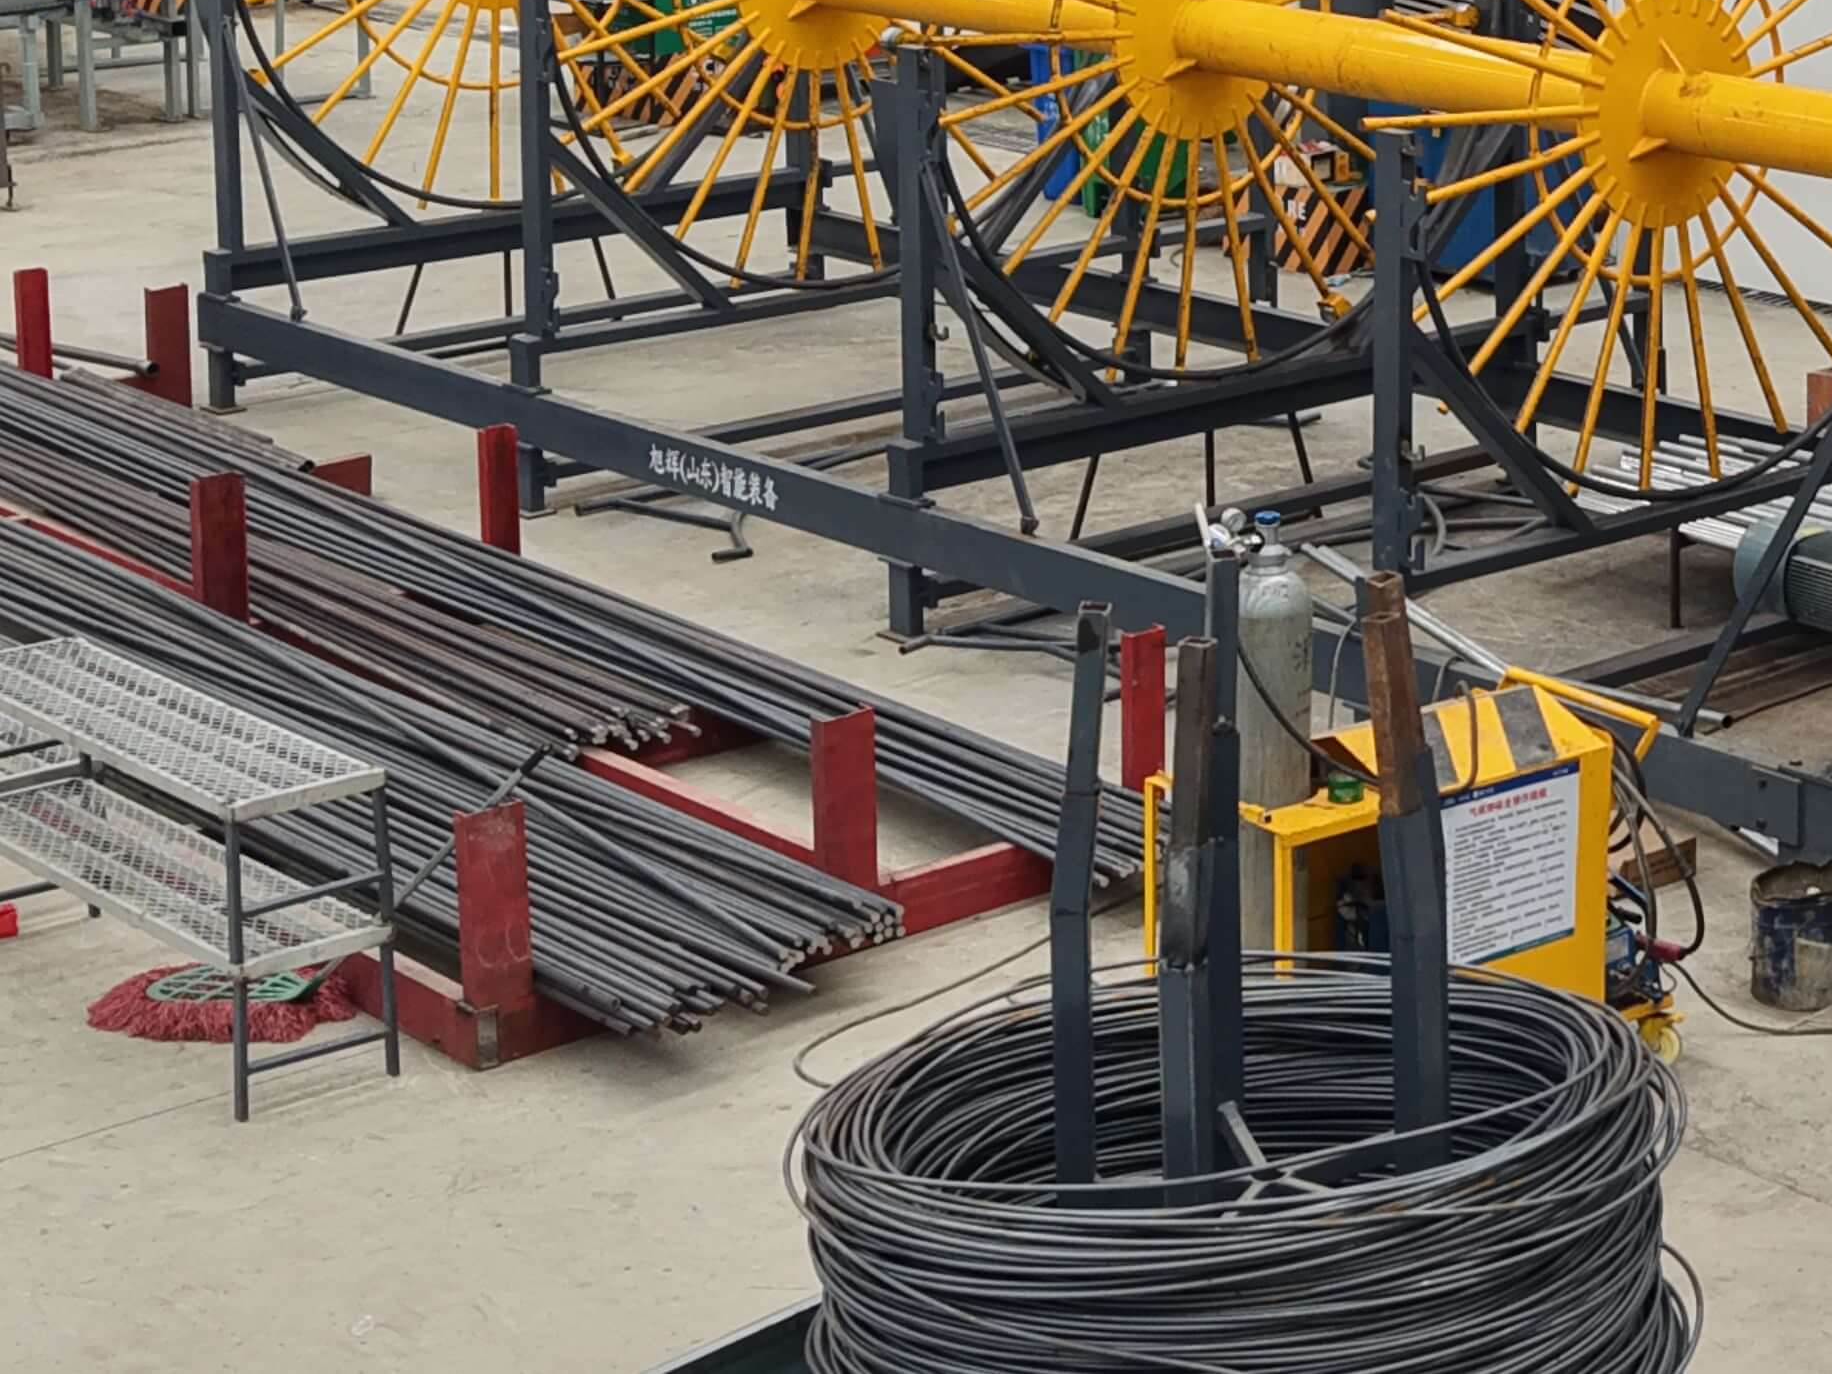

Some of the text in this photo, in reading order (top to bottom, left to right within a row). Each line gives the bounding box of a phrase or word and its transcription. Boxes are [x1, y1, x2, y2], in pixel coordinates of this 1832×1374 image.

[649, 443, 779, 511] 旭辉(山东)智能装备
